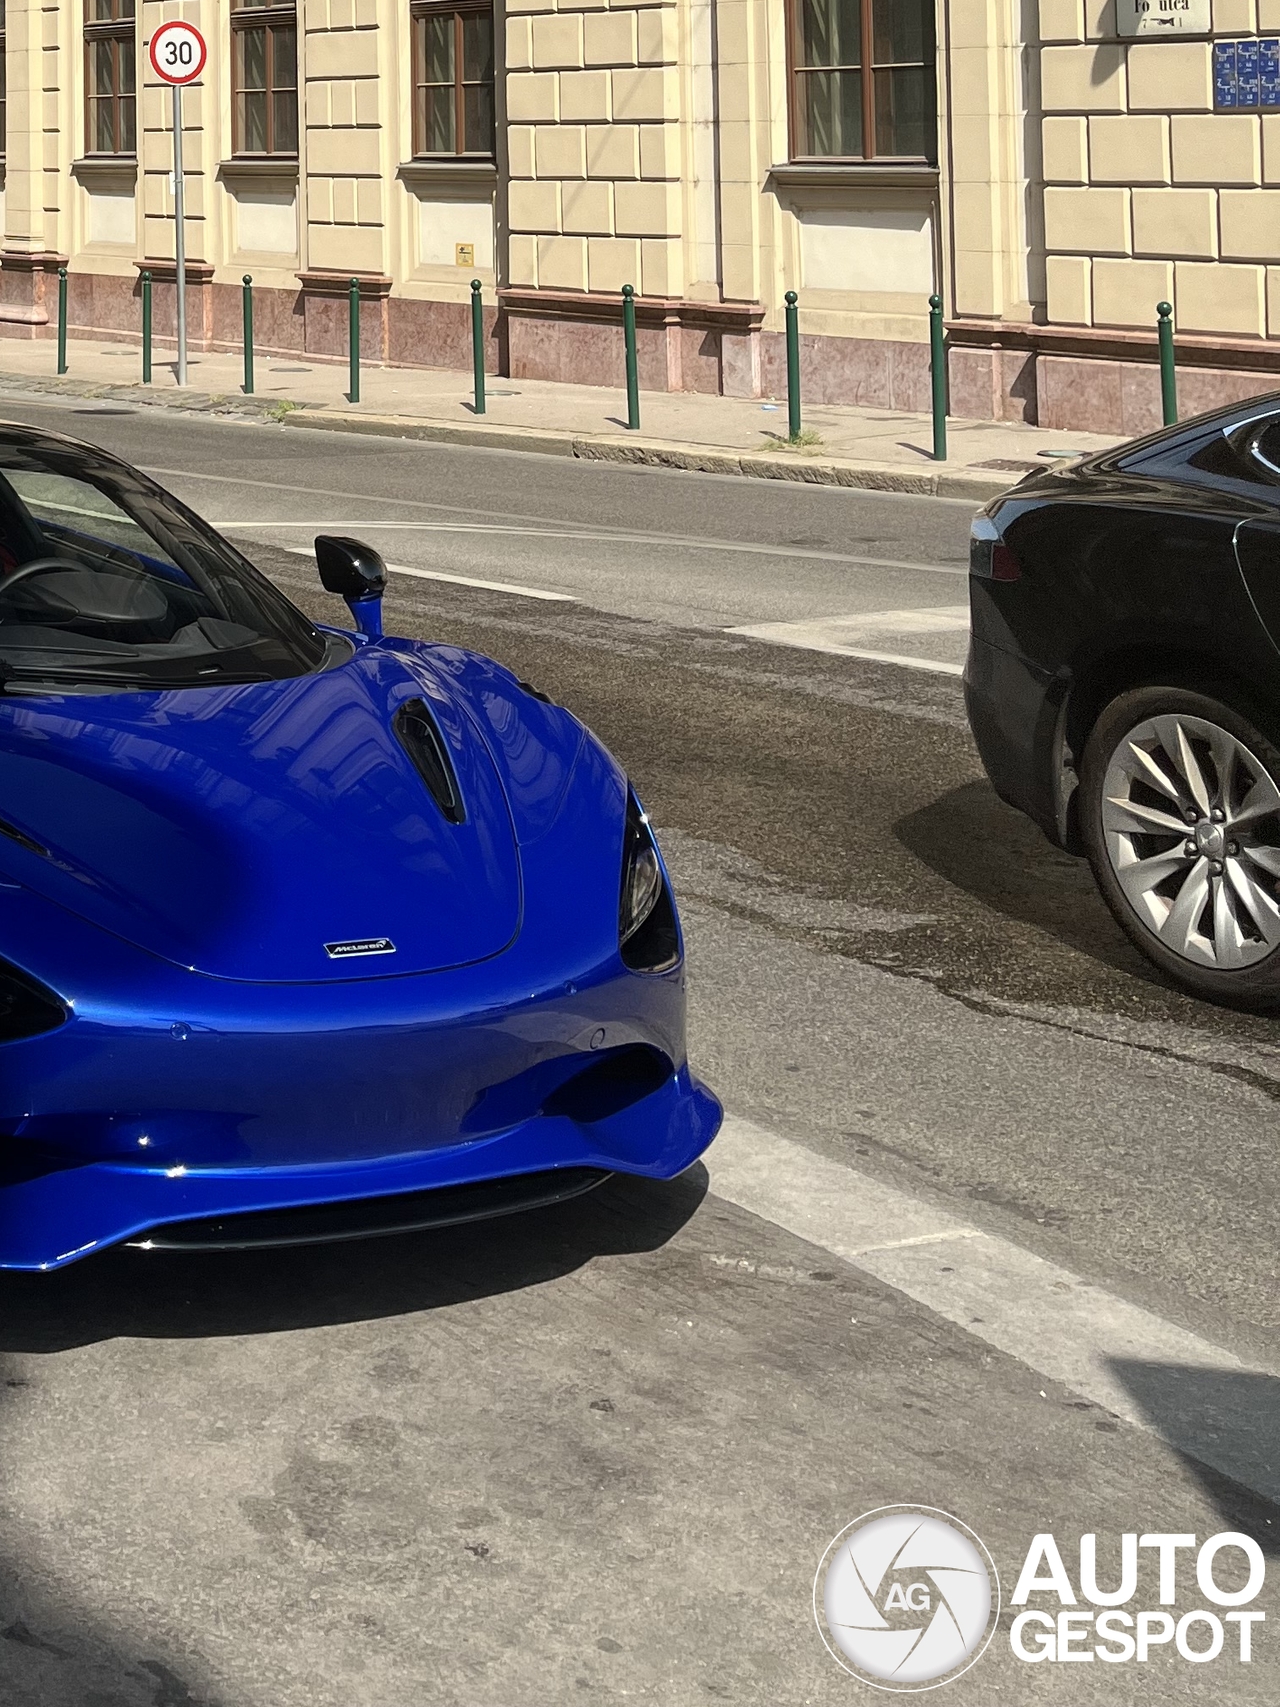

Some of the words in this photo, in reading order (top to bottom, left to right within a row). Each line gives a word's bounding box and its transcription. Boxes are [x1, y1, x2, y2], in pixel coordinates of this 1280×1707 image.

[1142, 18, 1148, 29] 7
[165, 41, 192, 65] 30
[333, 943, 385, 953] McLaren
